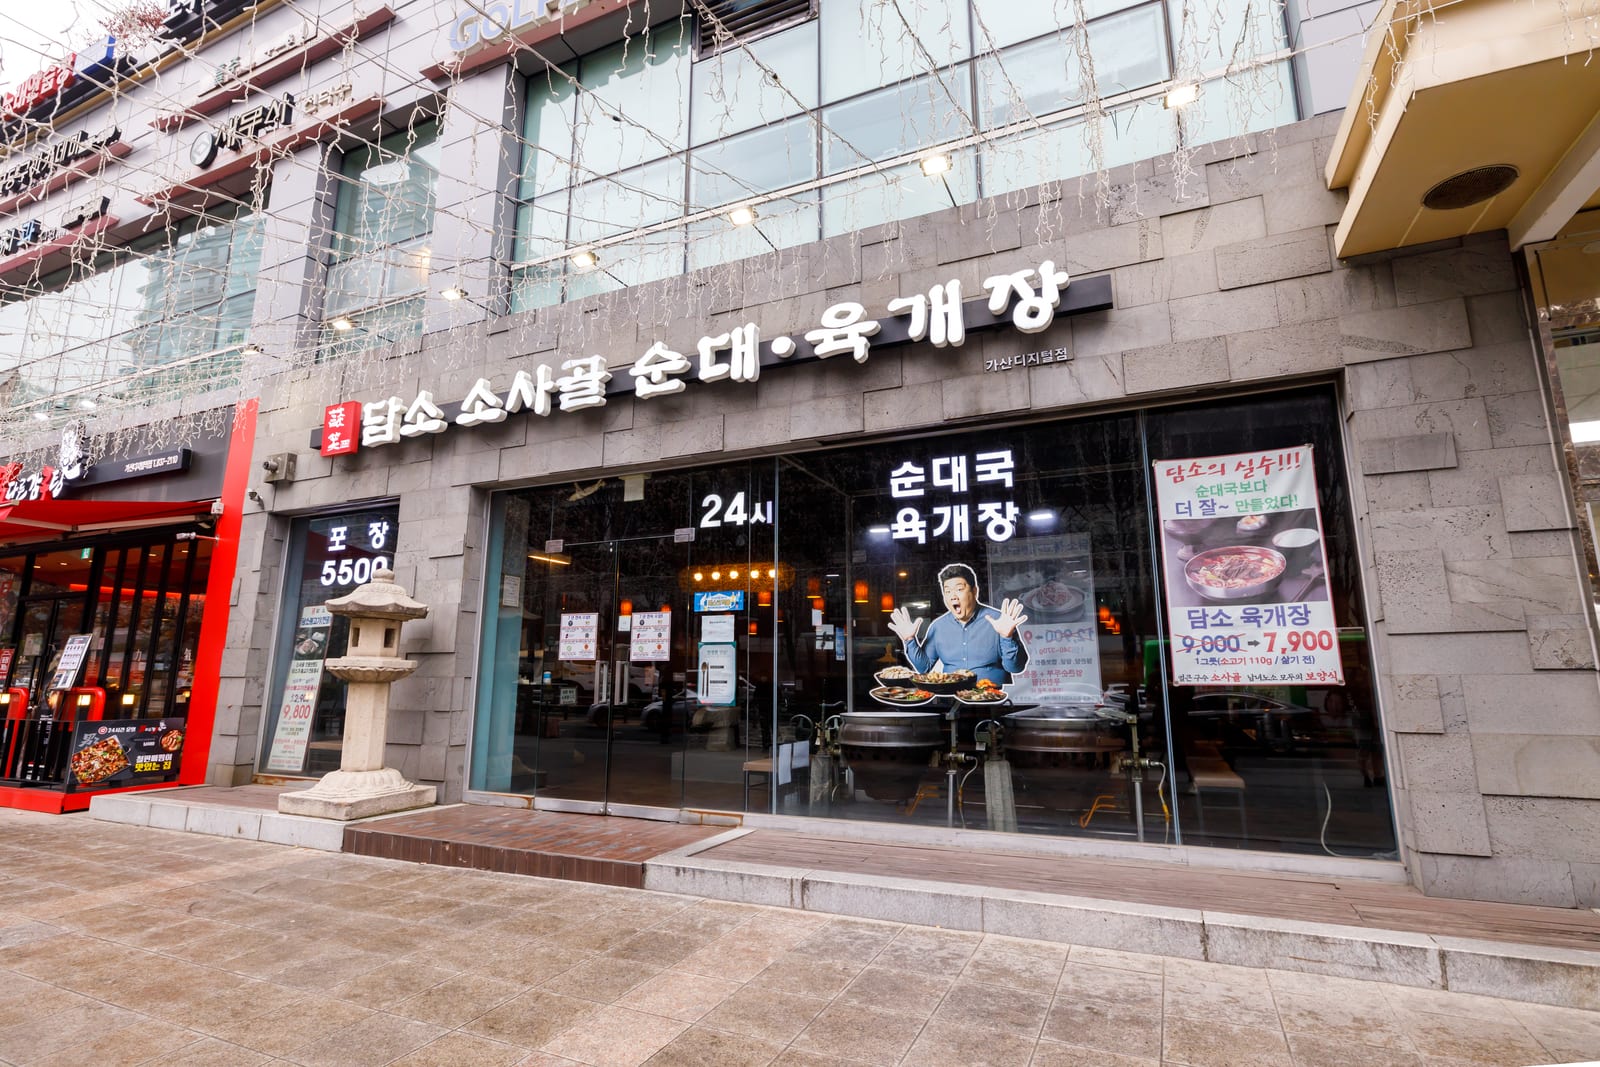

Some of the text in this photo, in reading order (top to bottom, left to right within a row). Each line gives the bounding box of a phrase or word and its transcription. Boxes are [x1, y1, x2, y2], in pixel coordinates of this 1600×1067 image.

[985, 347, 1068, 372] 가산디지털점
[362, 389, 448, 448] 담소
[455, 355, 612, 428] 소사골
[889, 449, 1015, 498] 순대국
[1166, 451, 1301, 484] 담소의 실수!!!
[1194, 479, 1268, 499] 순대국보다
[699, 491, 773, 528] 24시
[1175, 500, 1193, 517] 더
[1235, 494, 1298, 514] 만들었다!
[890, 501, 1020, 544] 육개장
[1187, 603, 1311, 630] 담소 육개장
[1181, 630, 1333, 656] 9,000 7,900
[1250, 657, 1273, 666] 110g
[1211, 671, 1242, 683] 소사골
[1305, 670, 1338, 682] 보양식
[283, 704, 311, 720] 9,800
